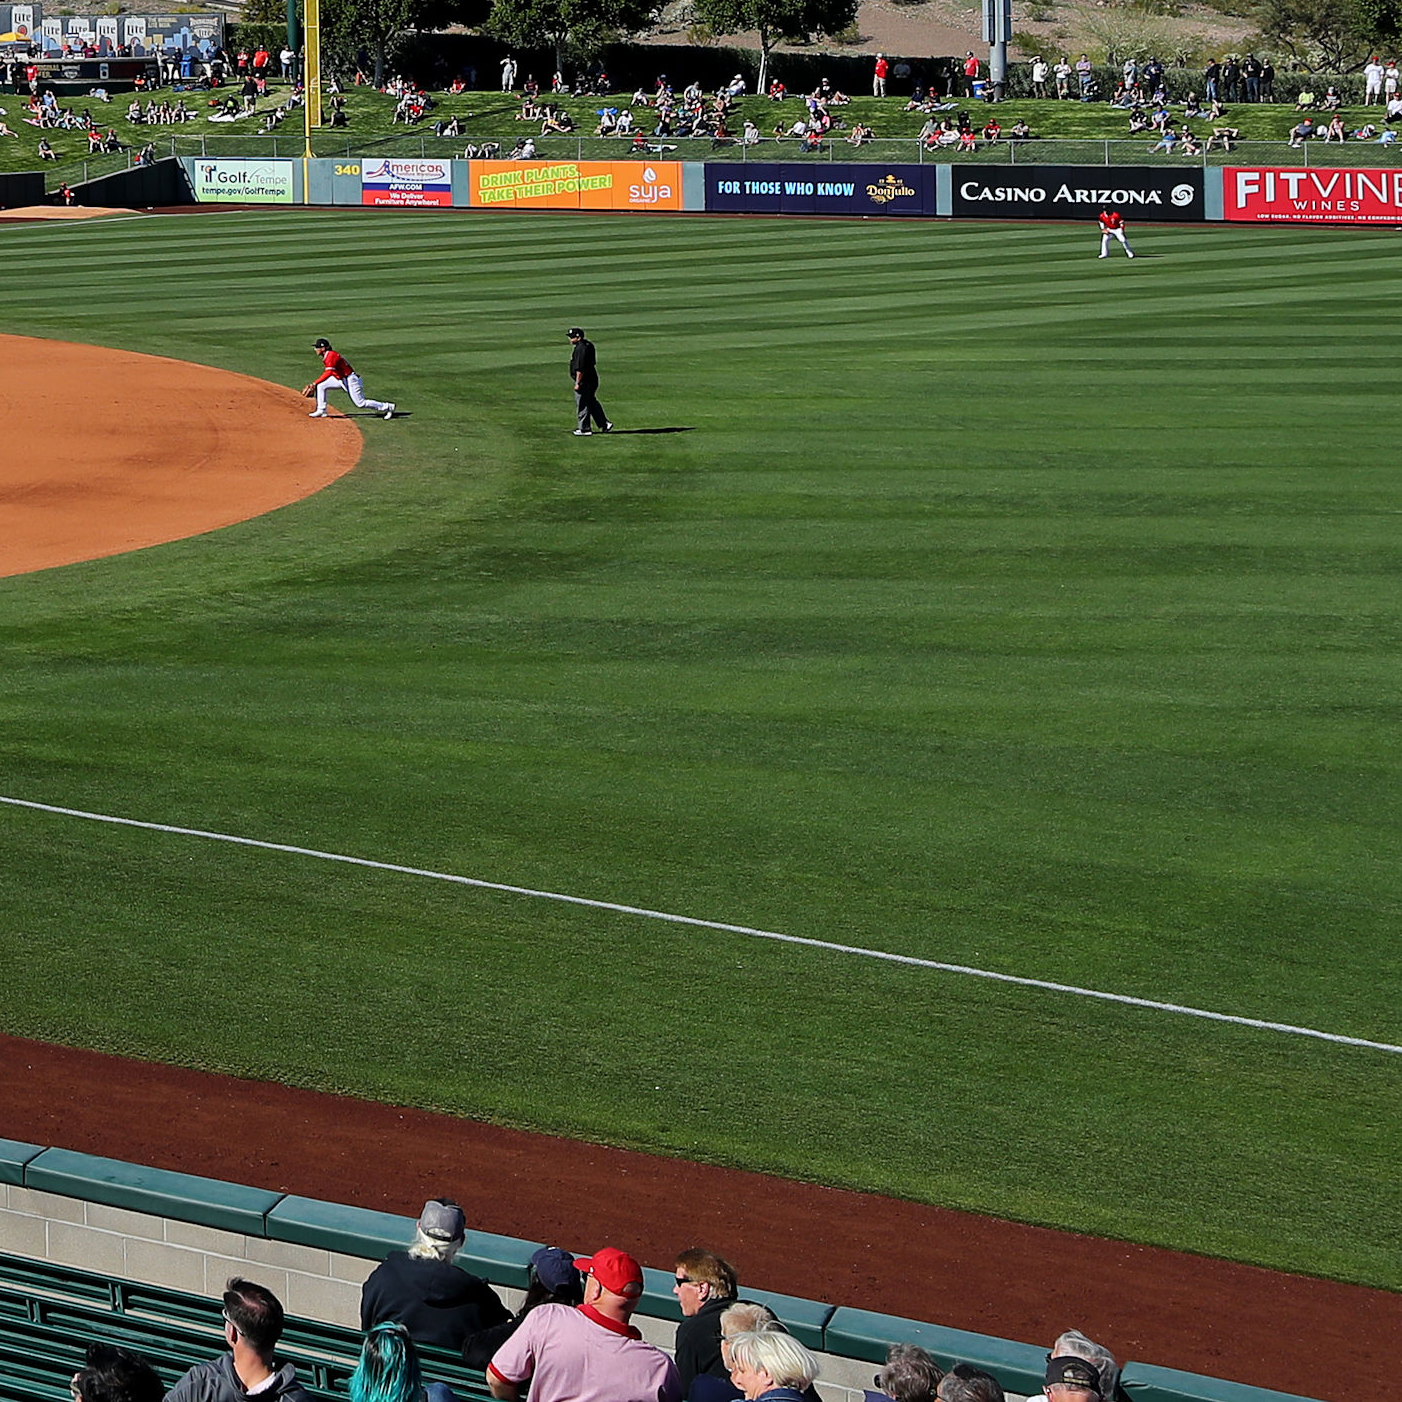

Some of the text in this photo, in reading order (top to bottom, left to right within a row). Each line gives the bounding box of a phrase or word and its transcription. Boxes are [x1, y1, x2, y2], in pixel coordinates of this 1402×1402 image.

[334, 165, 360, 176] 340
[254, 174, 287, 186] Tempe
[478, 173, 613, 203] TAKE THEIR POWER!
[480, 171, 522, 189] DRINK
[628, 184, 672, 203] suja
[717, 181, 855, 196] FOR THOSE WHO KNOW
[960, 181, 1162, 205] CASINO ARIZONA
[1293, 200, 1360, 211] WINES
